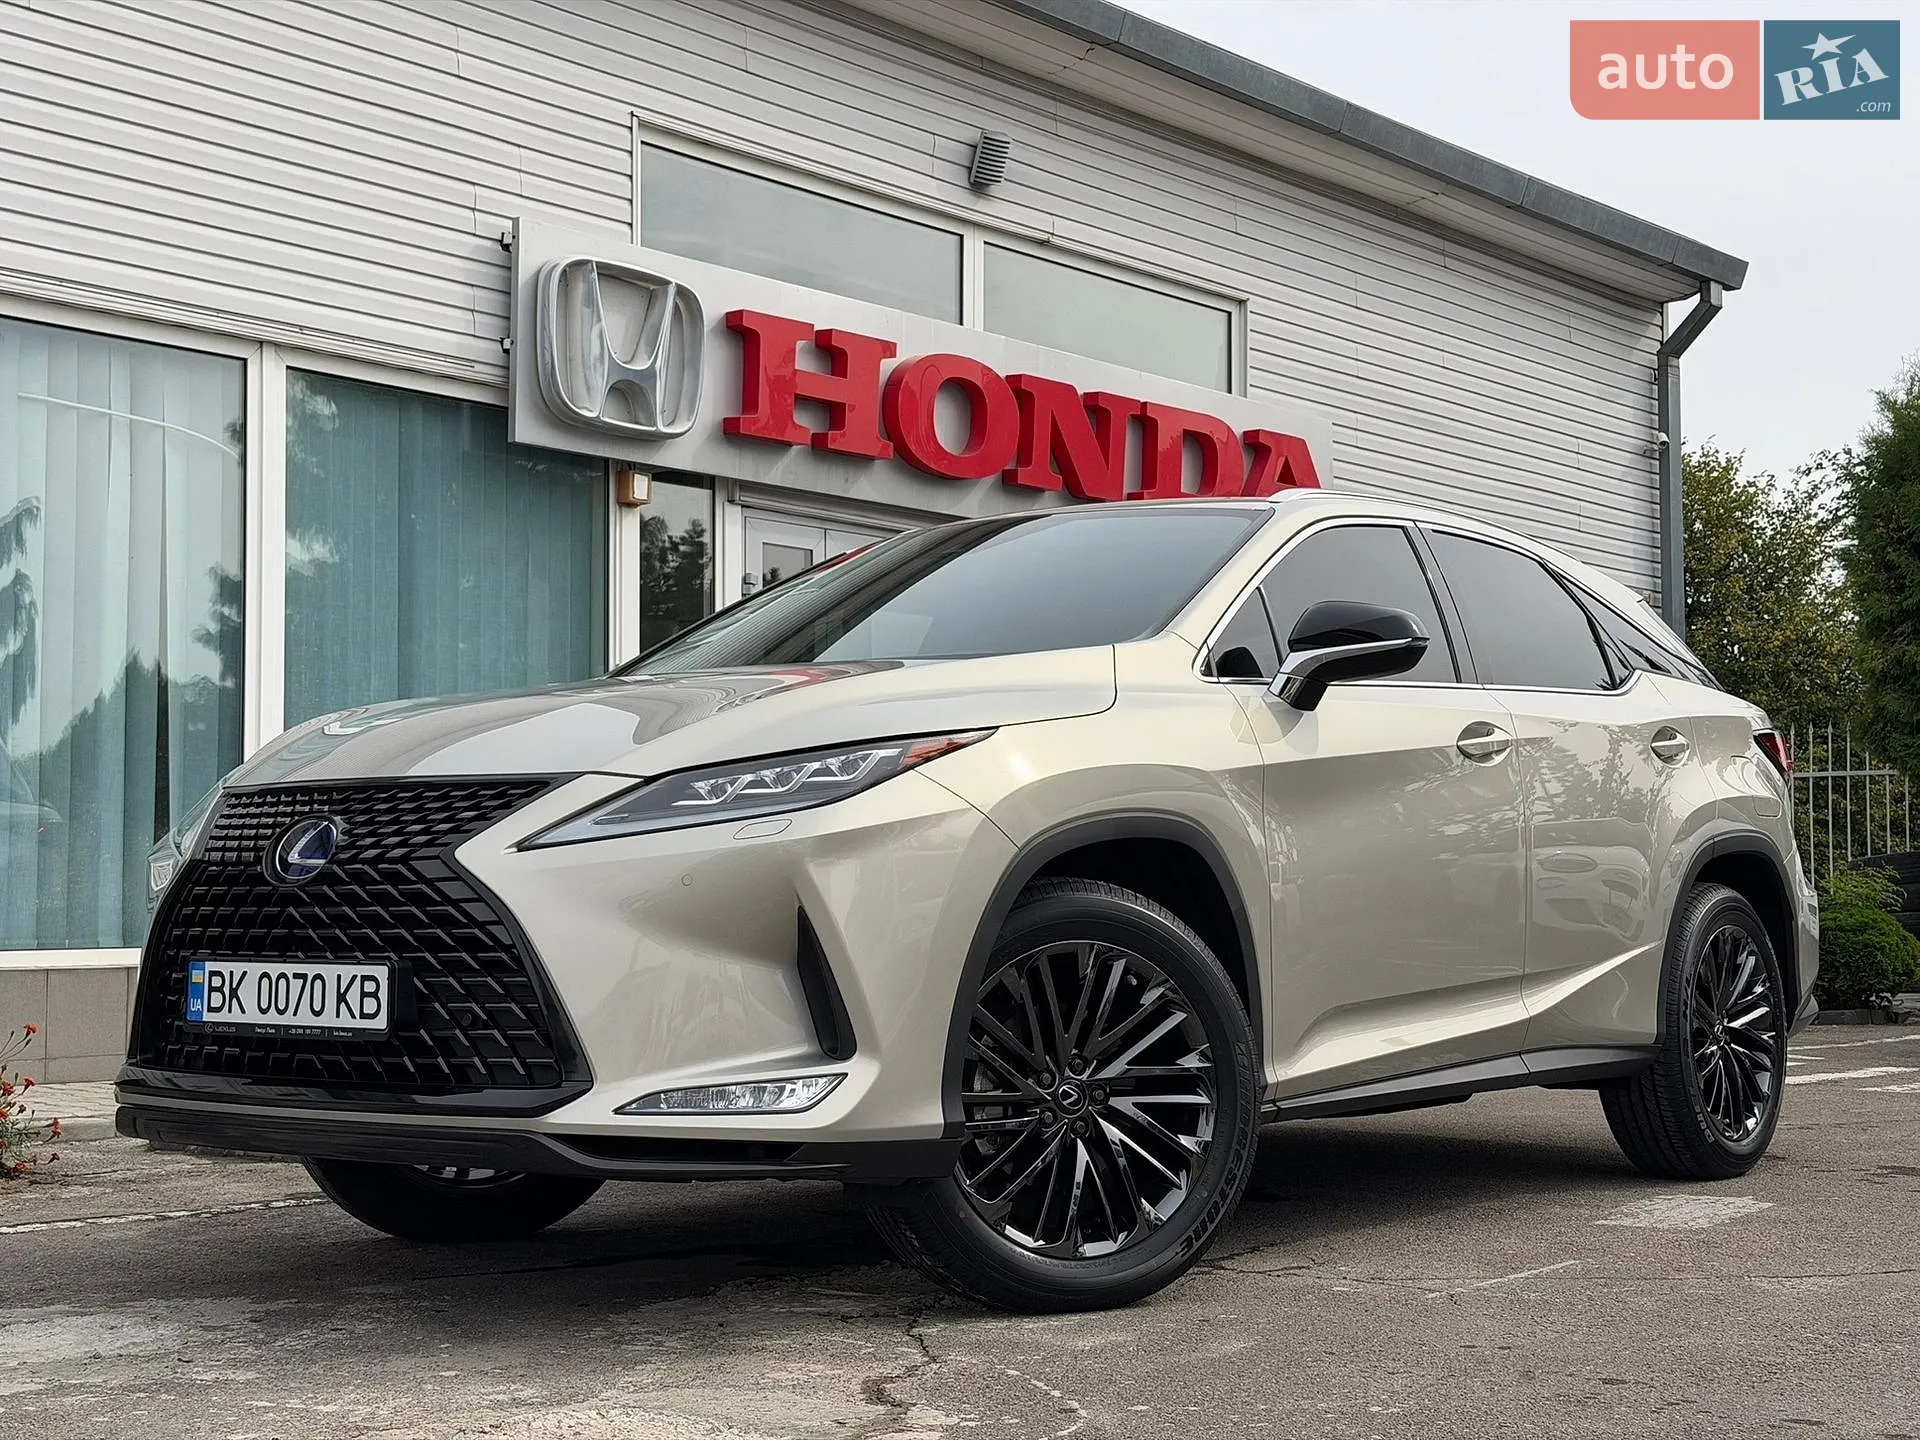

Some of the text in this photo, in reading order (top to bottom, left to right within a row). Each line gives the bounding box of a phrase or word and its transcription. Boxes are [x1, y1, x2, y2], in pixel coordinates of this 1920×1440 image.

[723, 308, 1323, 501] HONDA
[190, 998, 202, 1012] UA
[206, 970, 382, 1020] BK 0070 KB
